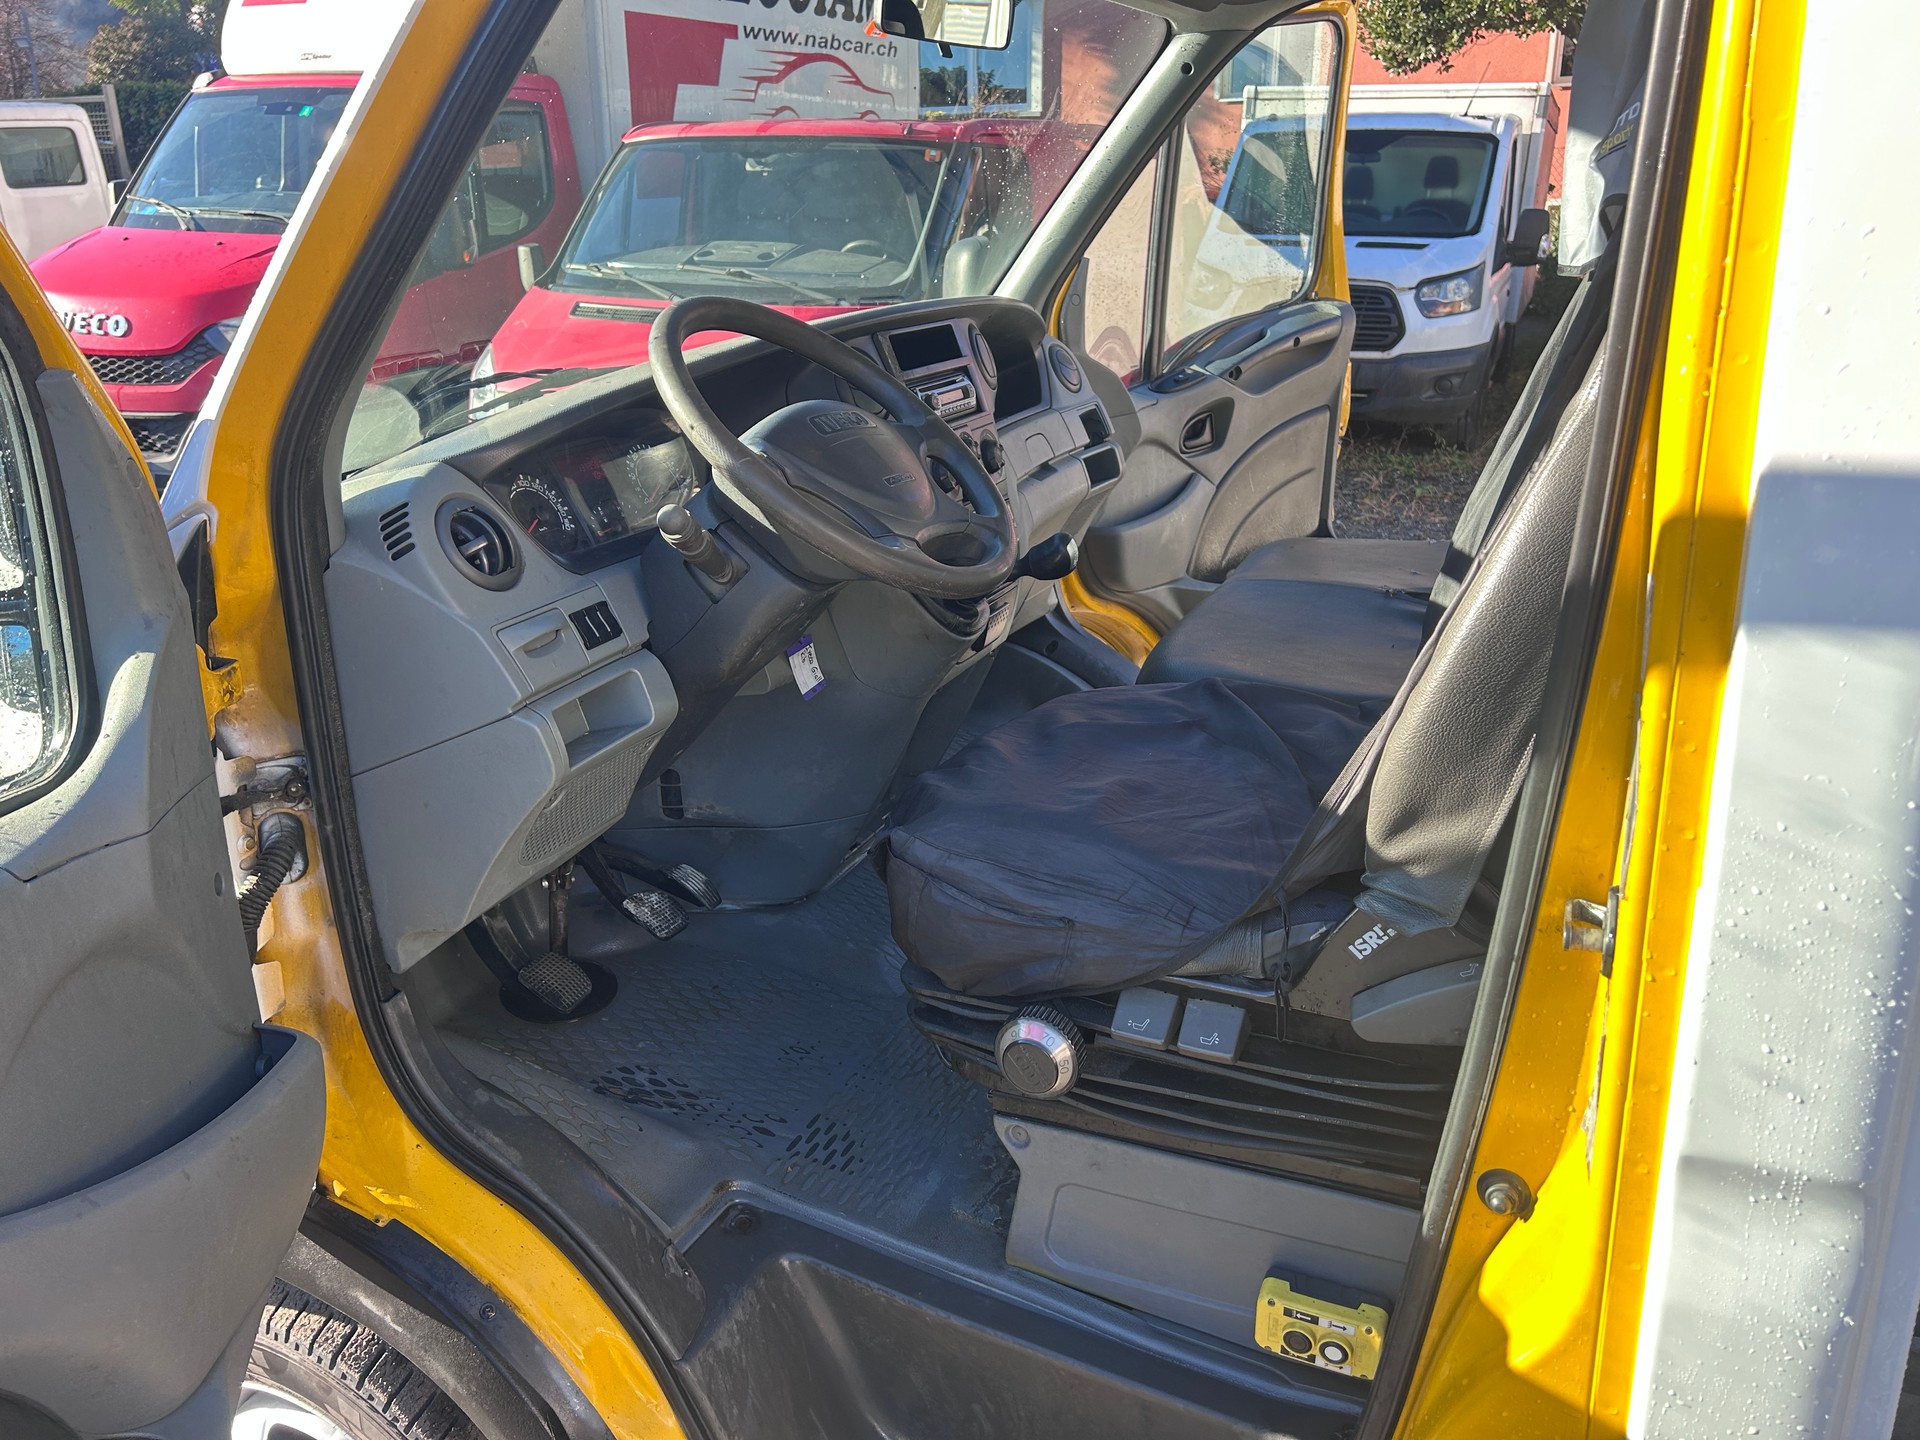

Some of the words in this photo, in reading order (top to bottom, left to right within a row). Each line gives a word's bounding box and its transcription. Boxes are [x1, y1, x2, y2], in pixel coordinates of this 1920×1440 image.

[742, 25, 898, 58] www.nabcar.ch
[1041, 1031, 1056, 1048] 70
[1058, 1059, 1070, 1075] 50
